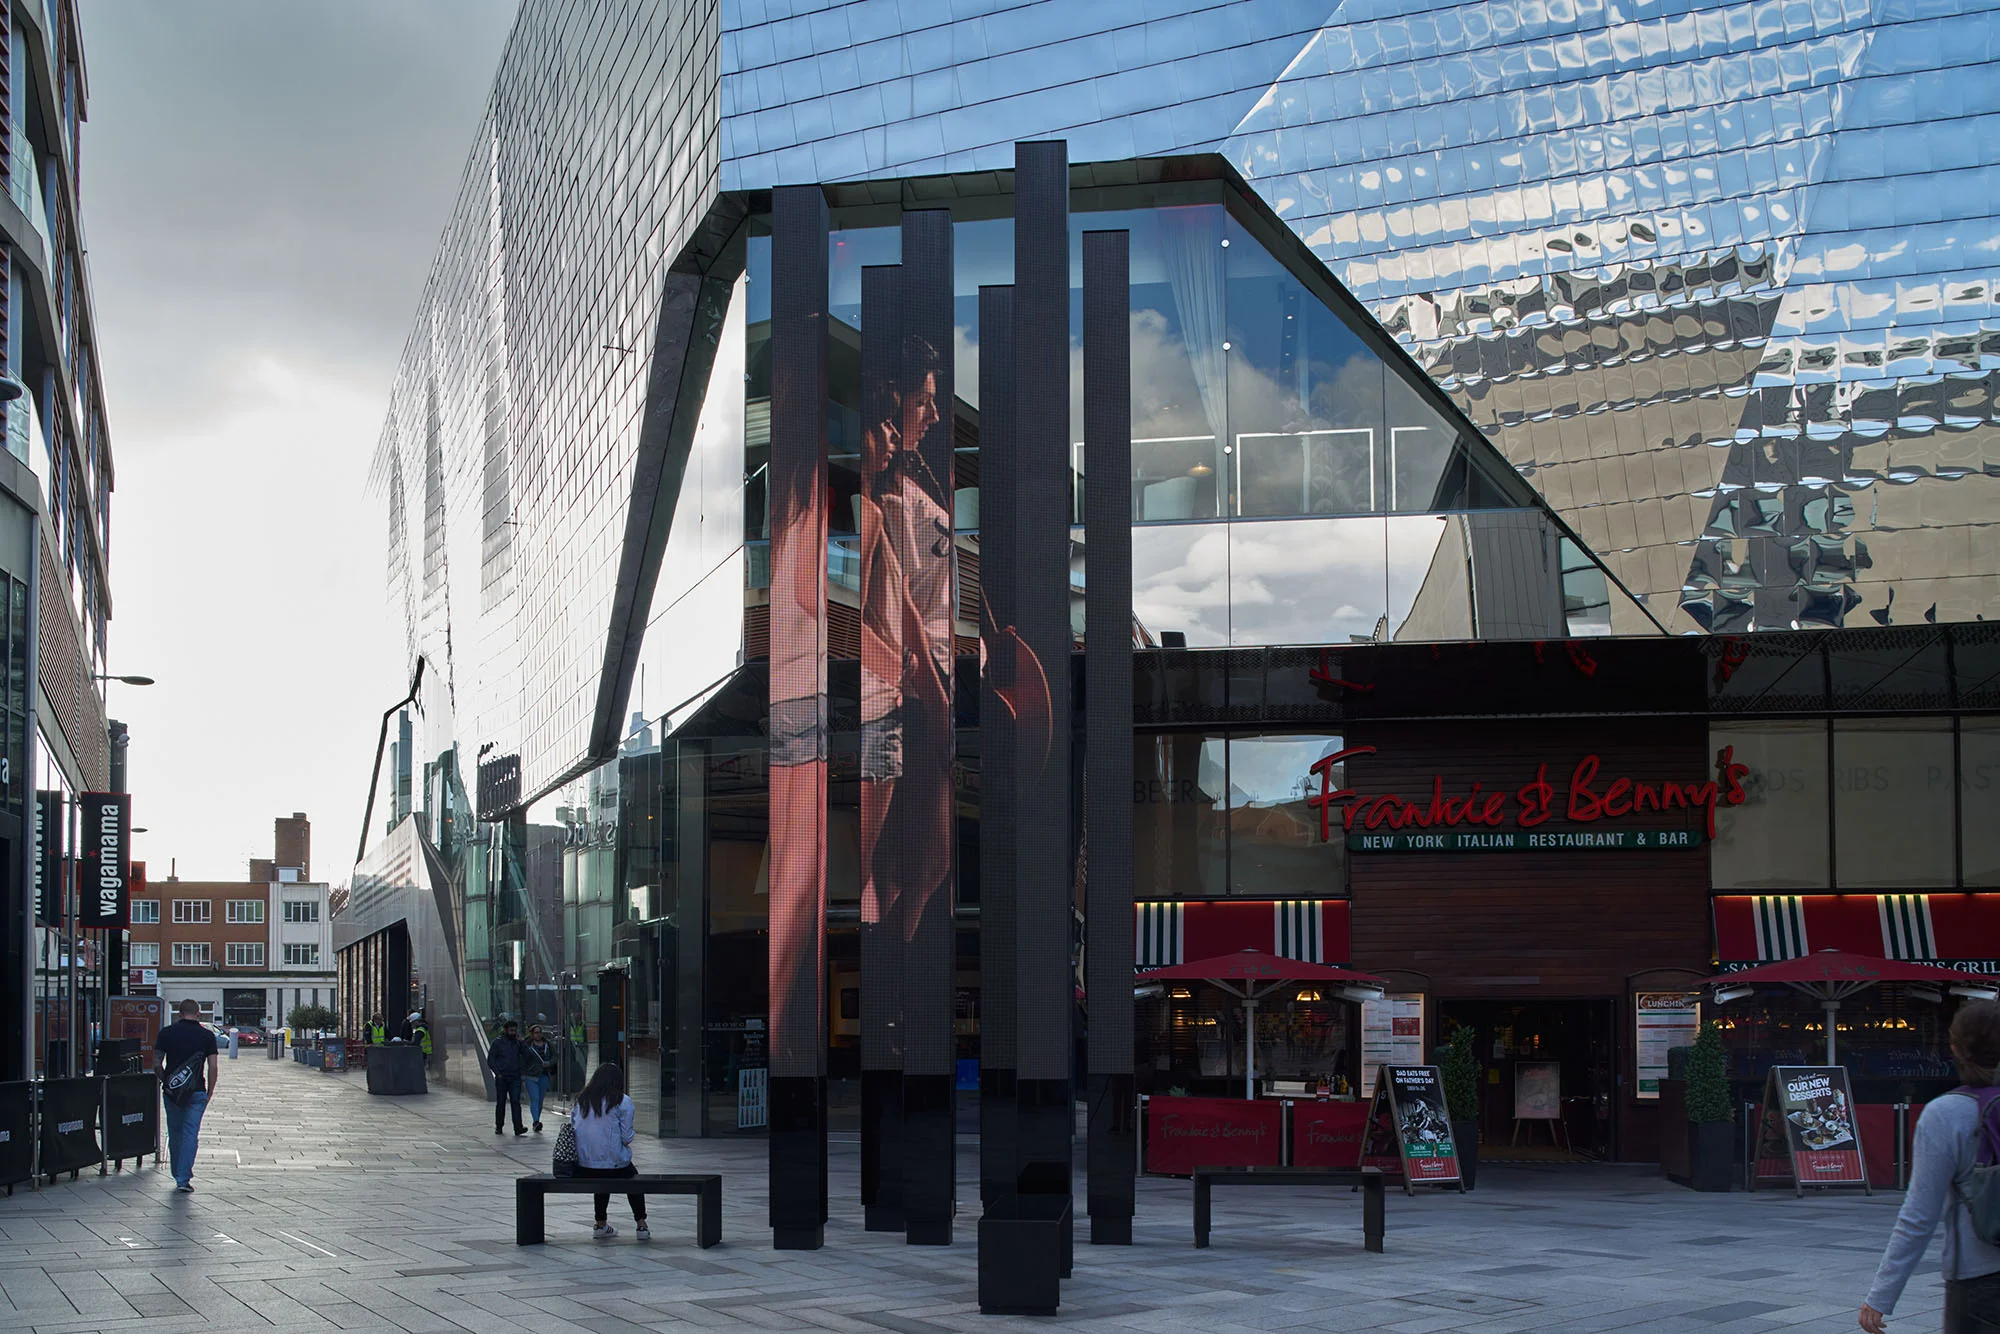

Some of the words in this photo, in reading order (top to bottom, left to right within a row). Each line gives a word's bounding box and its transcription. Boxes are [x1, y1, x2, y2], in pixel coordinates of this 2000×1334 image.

[1309, 745, 1507, 842] Frankie
[1517, 763, 1553, 828] &
[1568, 745, 1749, 840] Benny's
[1363, 834, 1394, 849] NEW
[1406, 834, 1444, 848] YORK
[1458, 833, 1515, 848] ITALIAN
[1529, 833, 1624, 847] RESTAURANT
[1637, 833, 1647, 846] &
[1659, 832, 1689, 845] BAR
[99, 803, 122, 917] wagamama
[1787, 1081, 1808, 1092] OUR
[1809, 1077, 1830, 1088] NEW
[1789, 1087, 1832, 1101] DESSERTS
[1161, 1113, 1208, 1140] Frankie
[1222, 1120, 1268, 1144] Benny's
[1307, 1119, 1354, 1145] Frankie
